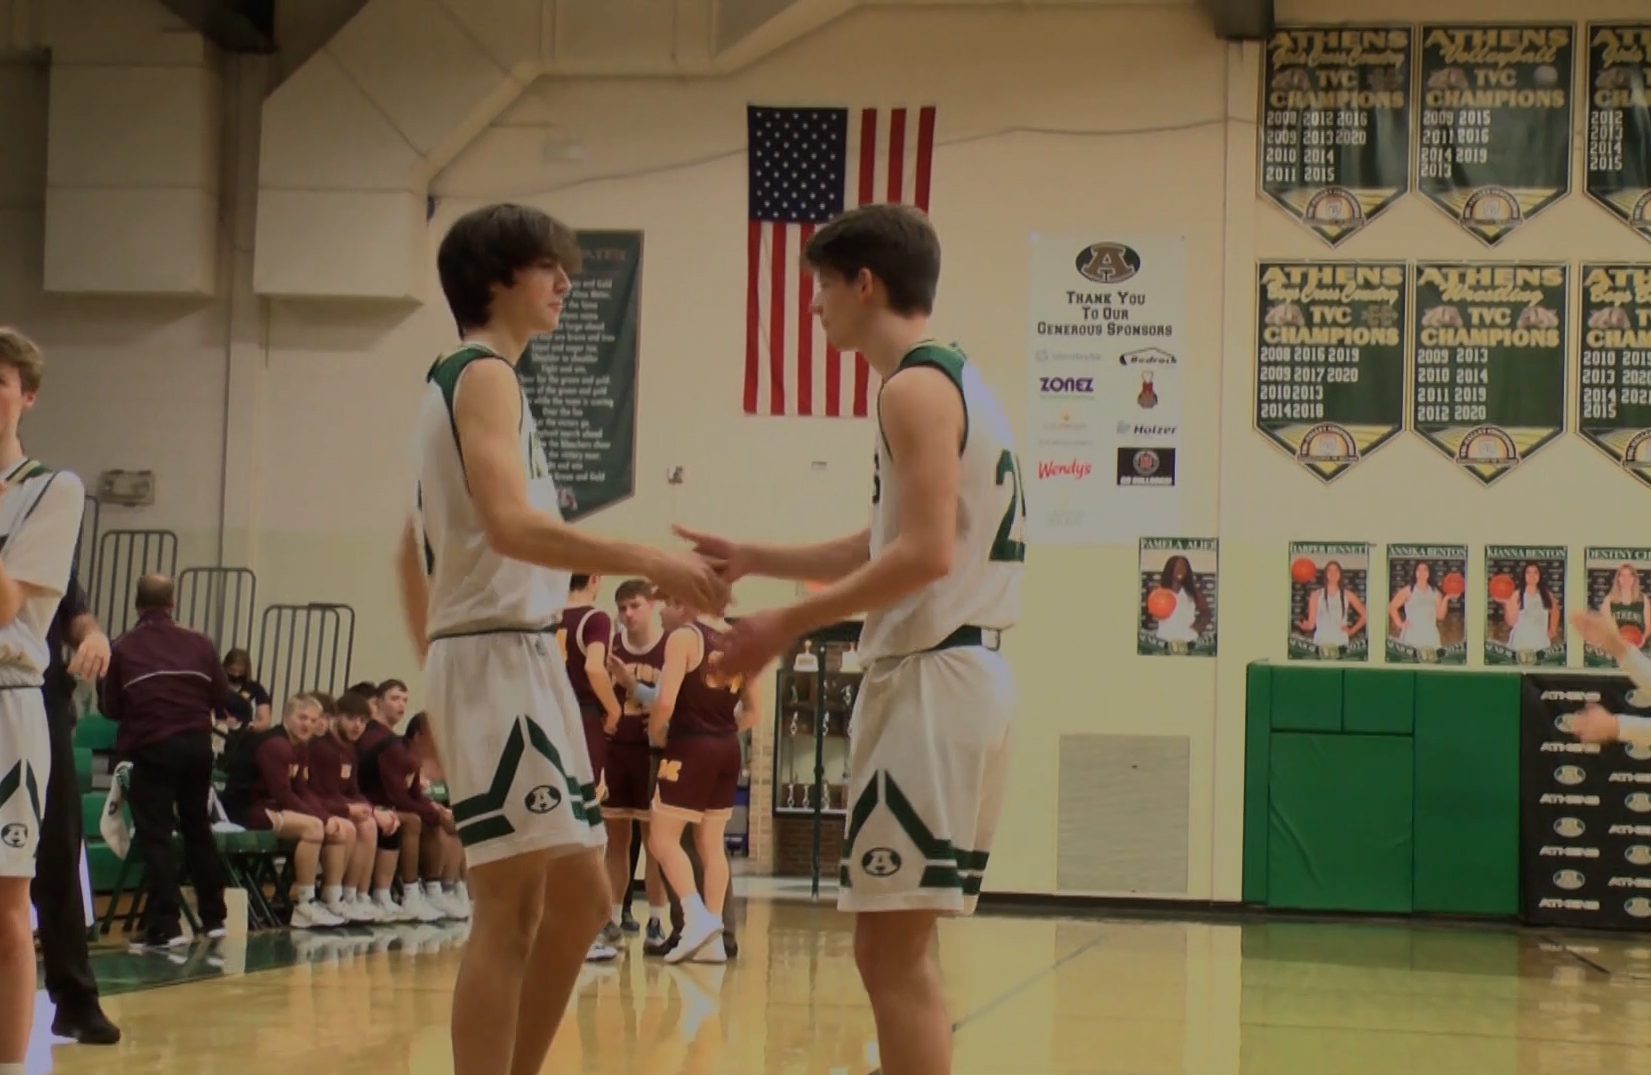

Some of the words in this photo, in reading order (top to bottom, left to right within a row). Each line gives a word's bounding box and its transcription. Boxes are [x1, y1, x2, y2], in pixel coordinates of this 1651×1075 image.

[1267, 30, 1408, 49] ATHENS
[1424, 28, 1568, 47] ATHENS
[1439, 44, 1556, 69] Volleyball
[1315, 70, 1358, 87] TVC
[1473, 69, 1517, 87] TVC
[1270, 90, 1404, 109] CHAMPIONS
[1426, 89, 1564, 109] CHAMPIONS
[1337, 111, 1367, 126] 2016
[1423, 110, 1454, 125] 2009
[1459, 110, 1491, 125] 2015
[1591, 111, 1622, 125] 2012
[1303, 130, 1334, 145] 2013
[1336, 130, 1367, 145] 2020
[1423, 128, 1453, 144] 2011
[1457, 128, 1489, 144] 2016
[1266, 148, 1296, 164] 2010
[1304, 148, 1334, 164] 2014
[1420, 147, 1452, 163] 2014
[1455, 147, 1487, 163] 2019
[1590, 141, 1621, 156] 2014
[1590, 157, 1622, 170] 2015
[1266, 167, 1296, 182] 2011
[1304, 167, 1335, 182] 2015
[1261, 266, 1402, 286] ATHENS
[1418, 267, 1563, 287] ATHENS
[1066, 291, 1112, 305] THANK
[1118, 291, 1146, 305] YOU
[1438, 282, 1545, 308] Wrestling
[1082, 306, 1099, 320] TO
[1103, 306, 1129, 320] OUR
[1310, 305, 1352, 324] TVC
[1468, 307, 1512, 326] TVC
[1037, 322, 1102, 336] GENEROUS
[1107, 322, 1172, 336] SPONSORS
[1263, 326, 1399, 345] CHAMPIONS
[1421, 328, 1560, 347] CHAMPIONS
[1260, 347, 1291, 362] 2008
[1294, 347, 1325, 362] 2016
[1328, 347, 1359, 362] 2019
[1418, 348, 1449, 364] 2009
[1456, 348, 1488, 364] 2013
[1583, 350, 1616, 366] 2010
[1260, 366, 1291, 382] 2009
[1294, 366, 1325, 382] 2017
[1327, 366, 1359, 382] 2020
[1418, 368, 1450, 383] 2010
[1456, 368, 1488, 383] 2014
[1582, 369, 1615, 384] 2013
[1260, 385, 1291, 400] 2010
[1292, 385, 1323, 400] 2013
[1417, 387, 1449, 402] 2011
[1455, 387, 1487, 402] 2019
[1584, 388, 1616, 403] 2014
[1261, 403, 1292, 419] 2014
[1292, 403, 1323, 419] 2018
[1417, 405, 1449, 421] 2012
[1454, 405, 1486, 421] 2020
[1584, 402, 1616, 418] 2015
[1134, 424, 1177, 434] Holzer
[988, 448, 1026, 562] 2
